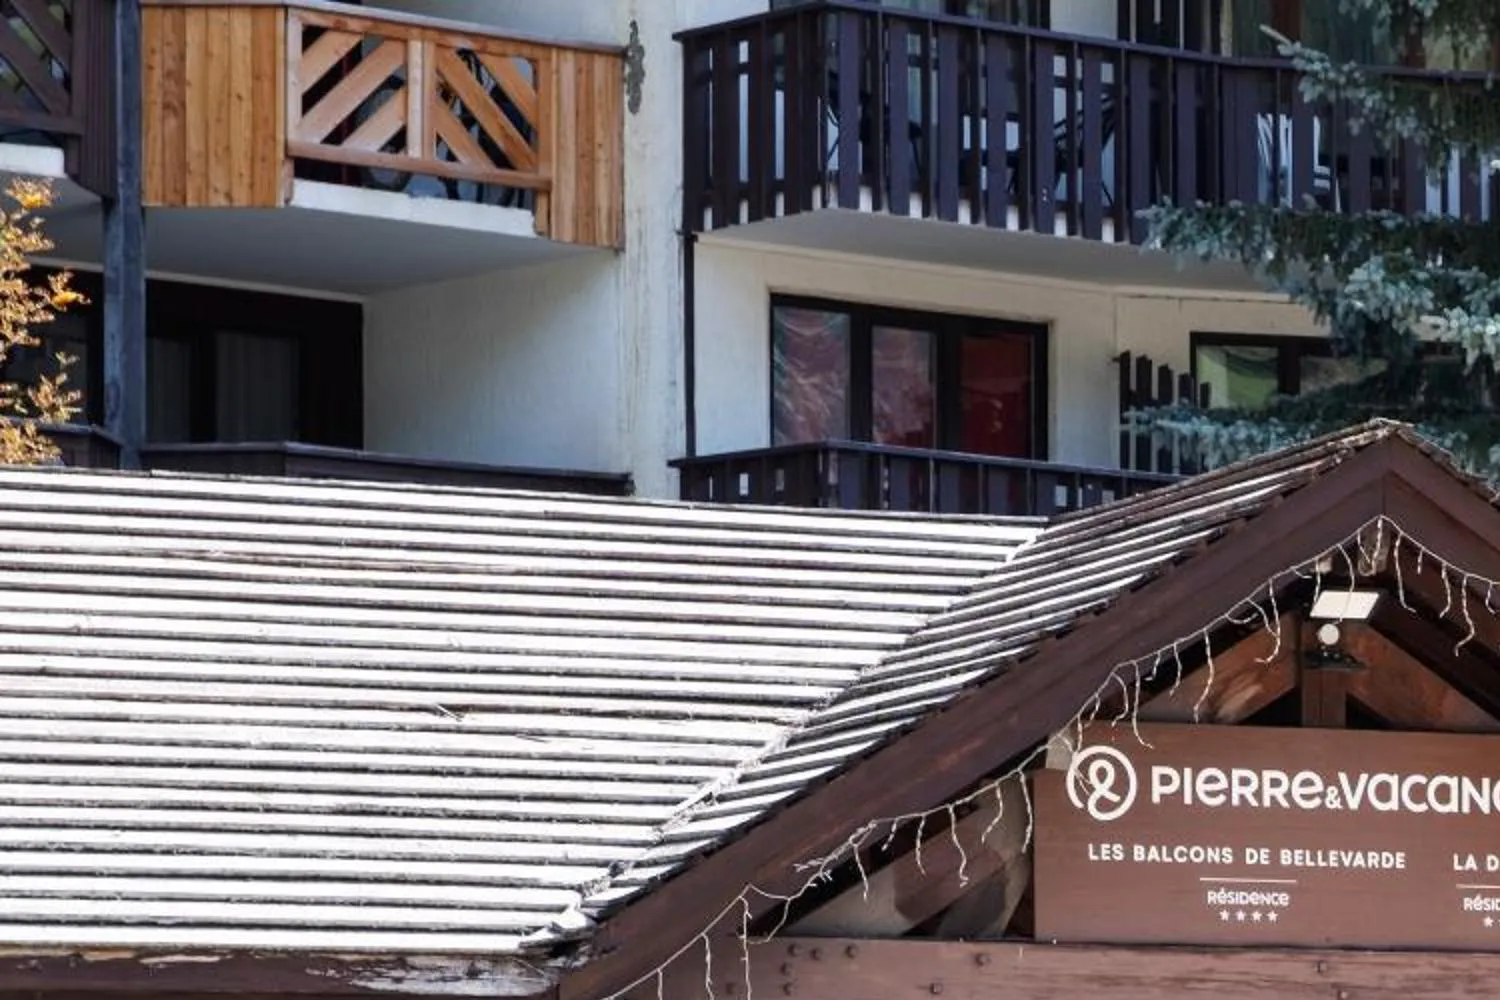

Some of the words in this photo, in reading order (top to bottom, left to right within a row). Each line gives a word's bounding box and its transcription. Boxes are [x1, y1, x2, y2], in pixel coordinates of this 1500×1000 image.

[1088, 843, 1125, 862] LES
[1133, 844, 1234, 865] BALCONS
[1245, 848, 1271, 866] DE
[1280, 848, 1406, 870] BELLEVARDE
[1453, 853, 1478, 871] LA
